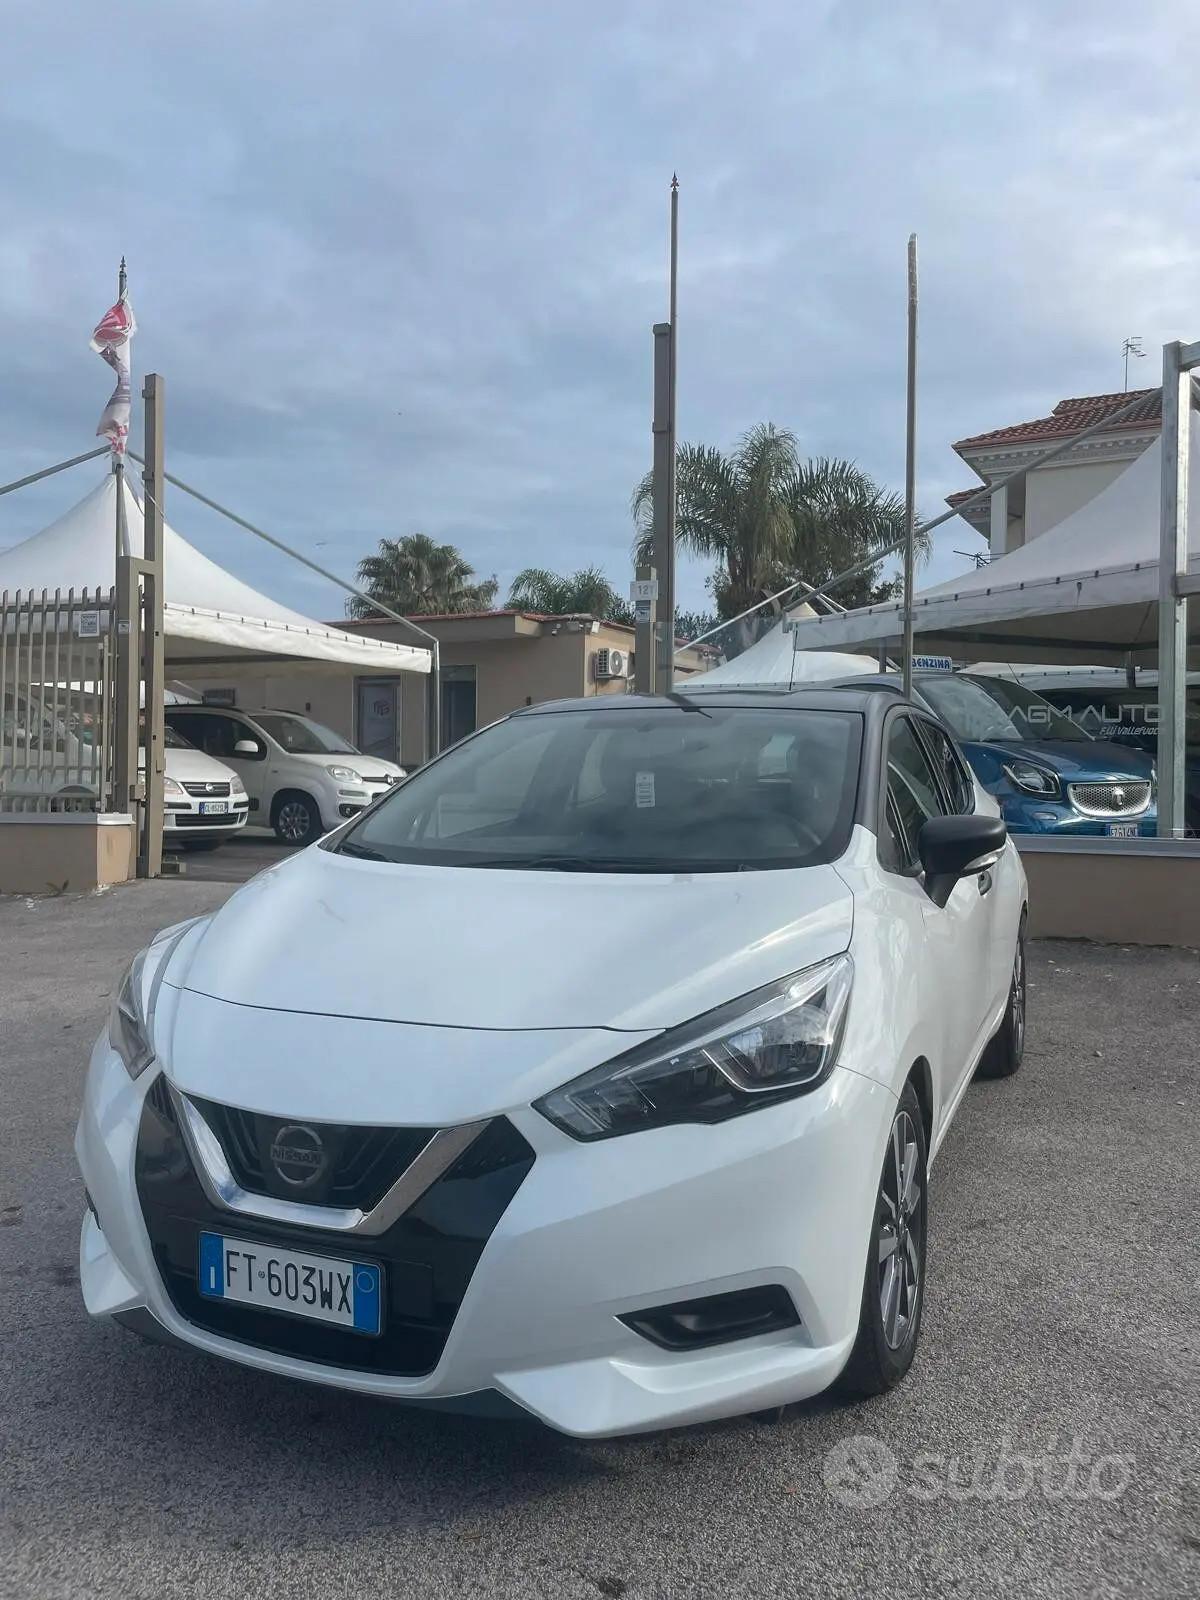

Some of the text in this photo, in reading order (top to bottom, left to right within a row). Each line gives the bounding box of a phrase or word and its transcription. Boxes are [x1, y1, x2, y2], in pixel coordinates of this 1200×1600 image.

[911, 657, 950, 670] BENZINA
[1080, 704, 1165, 724] AUTO
[272, 1147, 320, 1166] NISSAN
